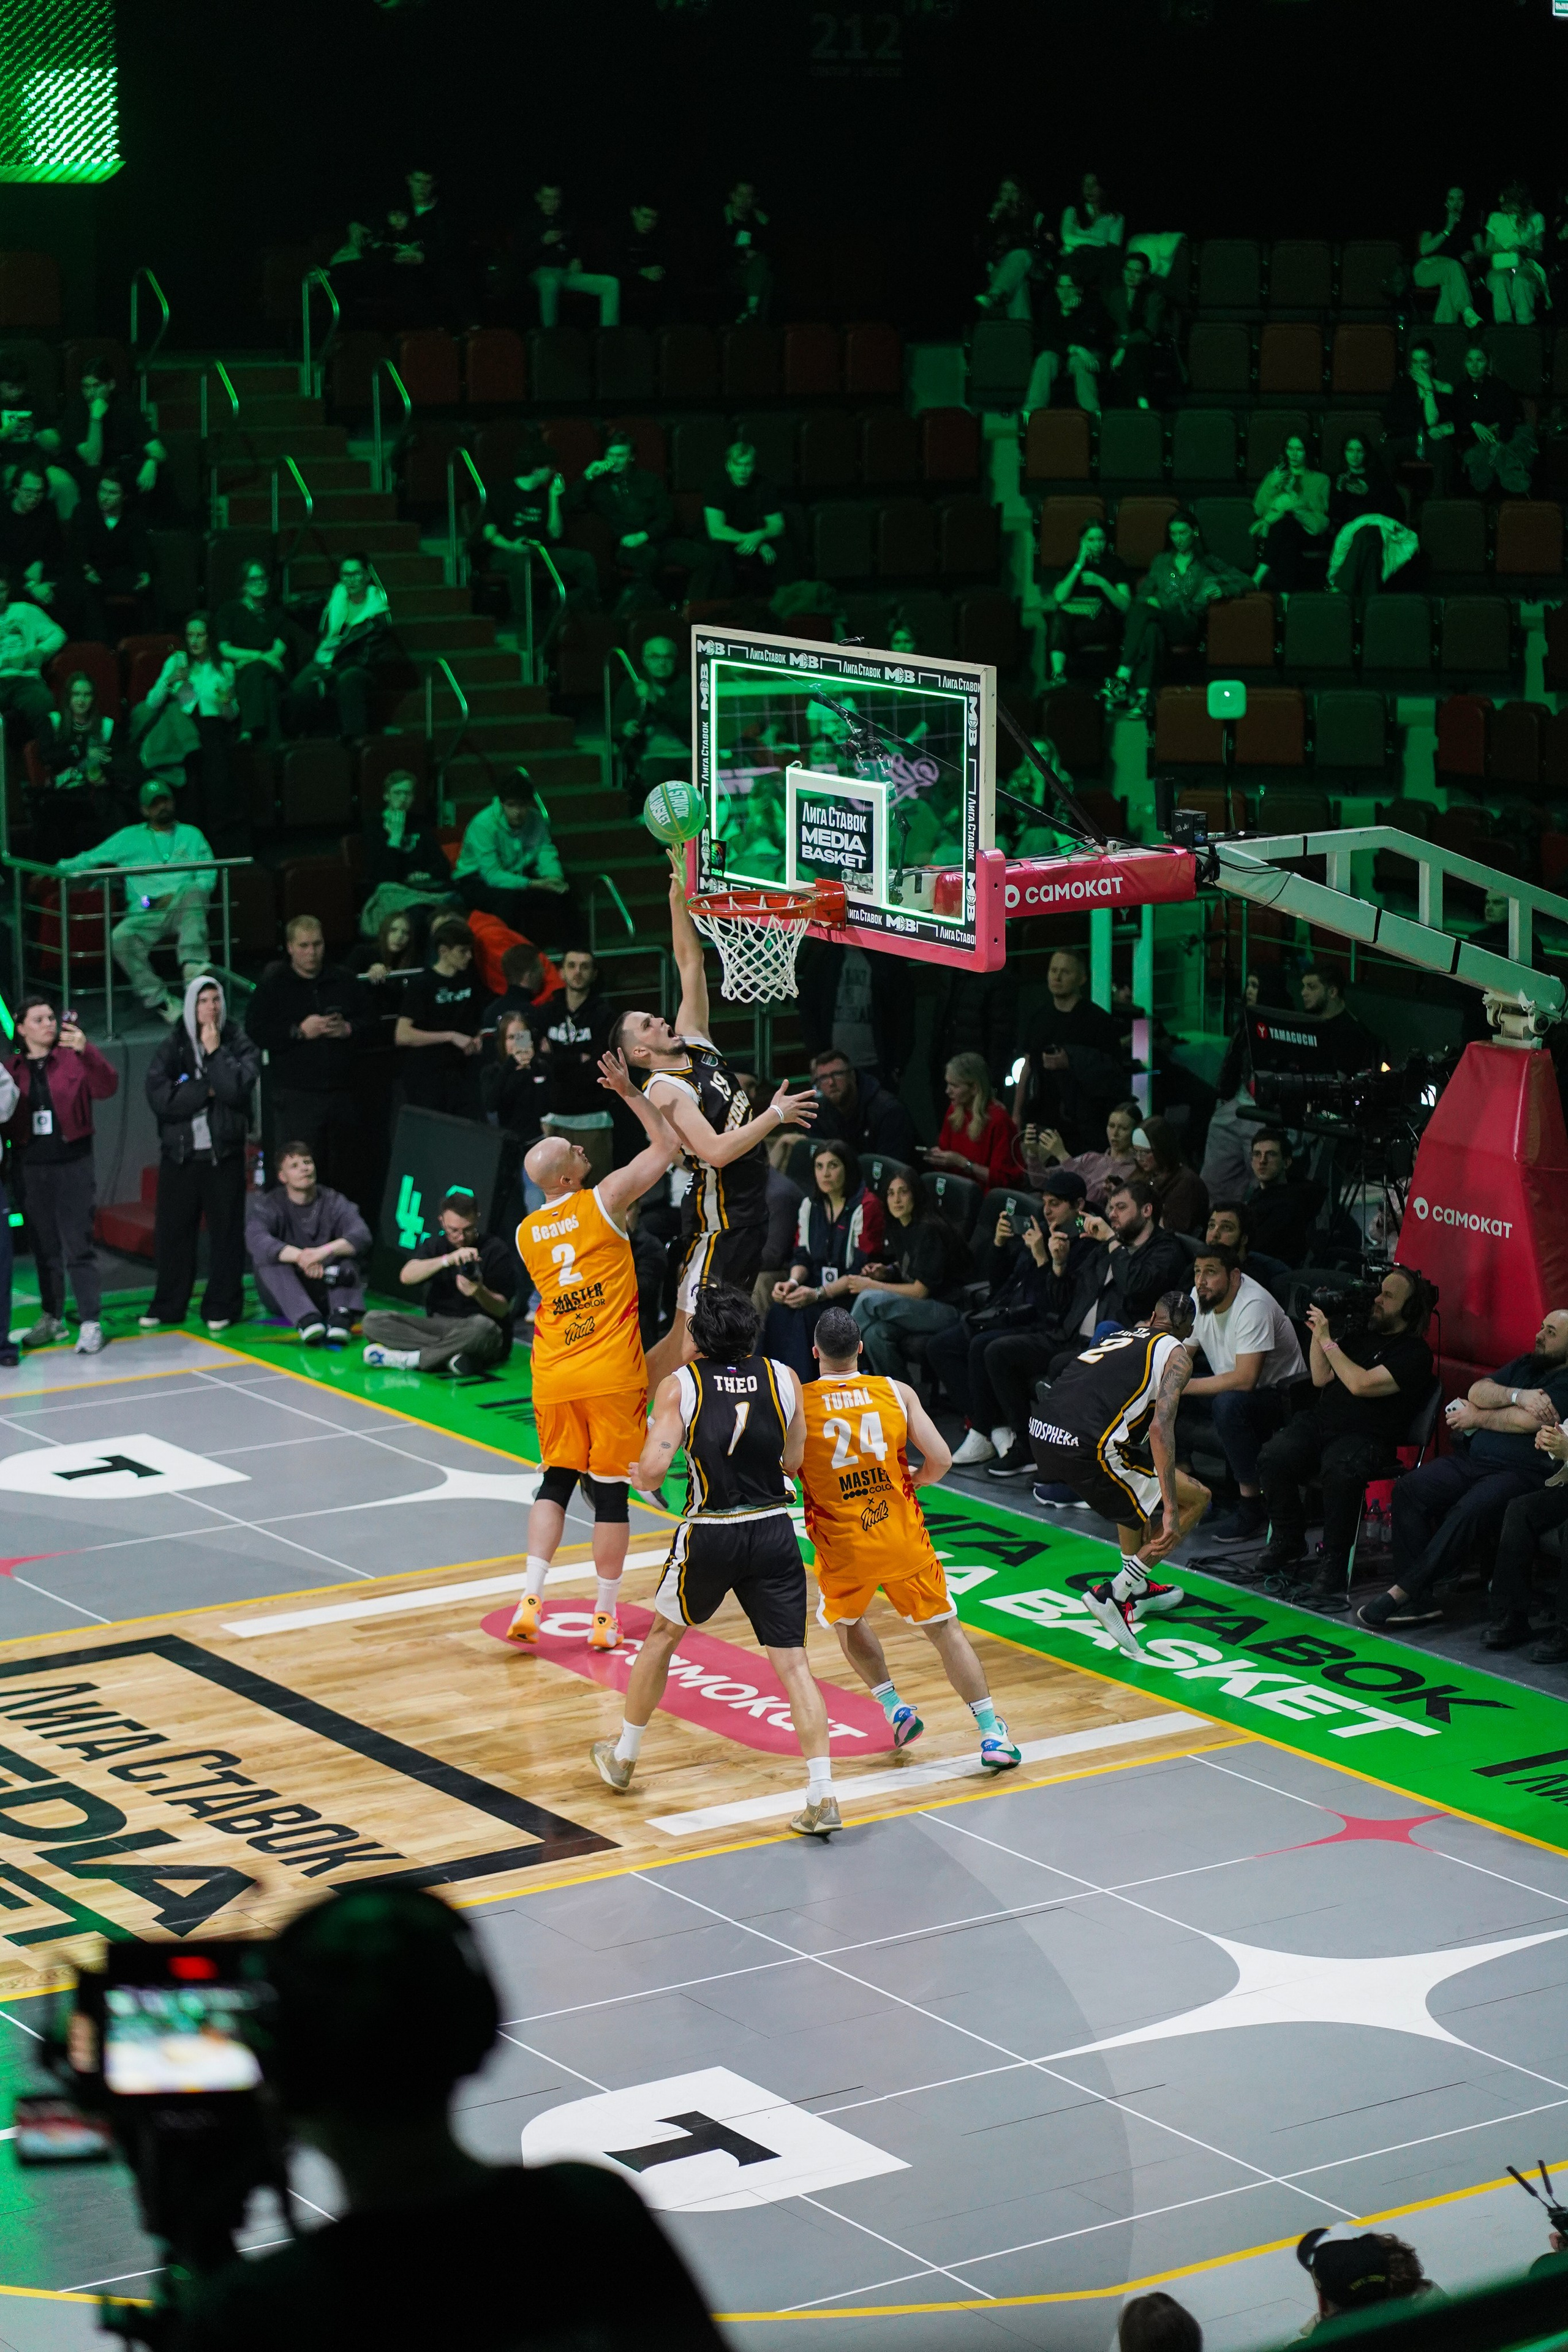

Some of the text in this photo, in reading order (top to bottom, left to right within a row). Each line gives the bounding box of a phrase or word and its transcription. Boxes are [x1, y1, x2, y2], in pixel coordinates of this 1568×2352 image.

[811, 13, 902, 59] 212
[651, 798, 672, 826] BASKET
[802, 825, 867, 854] MEDIA
[802, 844, 867, 869] BASKET
[1025, 876, 1124, 904] самокат
[1268, 1027, 1317, 1047] YAMAGUCHI
[531, 1214, 579, 1243] Beaves
[1432, 1205, 1513, 1239] самокат
[551, 1243, 584, 1287] 2
[552, 1282, 604, 1313] MASTER
[577, 1298, 606, 1310] COLOR
[1077, 1337, 1134, 1365] 2
[713, 1375, 758, 1393] THEO
[821, 1387, 873, 1412] TURAL
[727, 1401, 750, 1457] 1
[823, 1411, 889, 1470] 24
[980, 1588, 1442, 1738] BASKET
